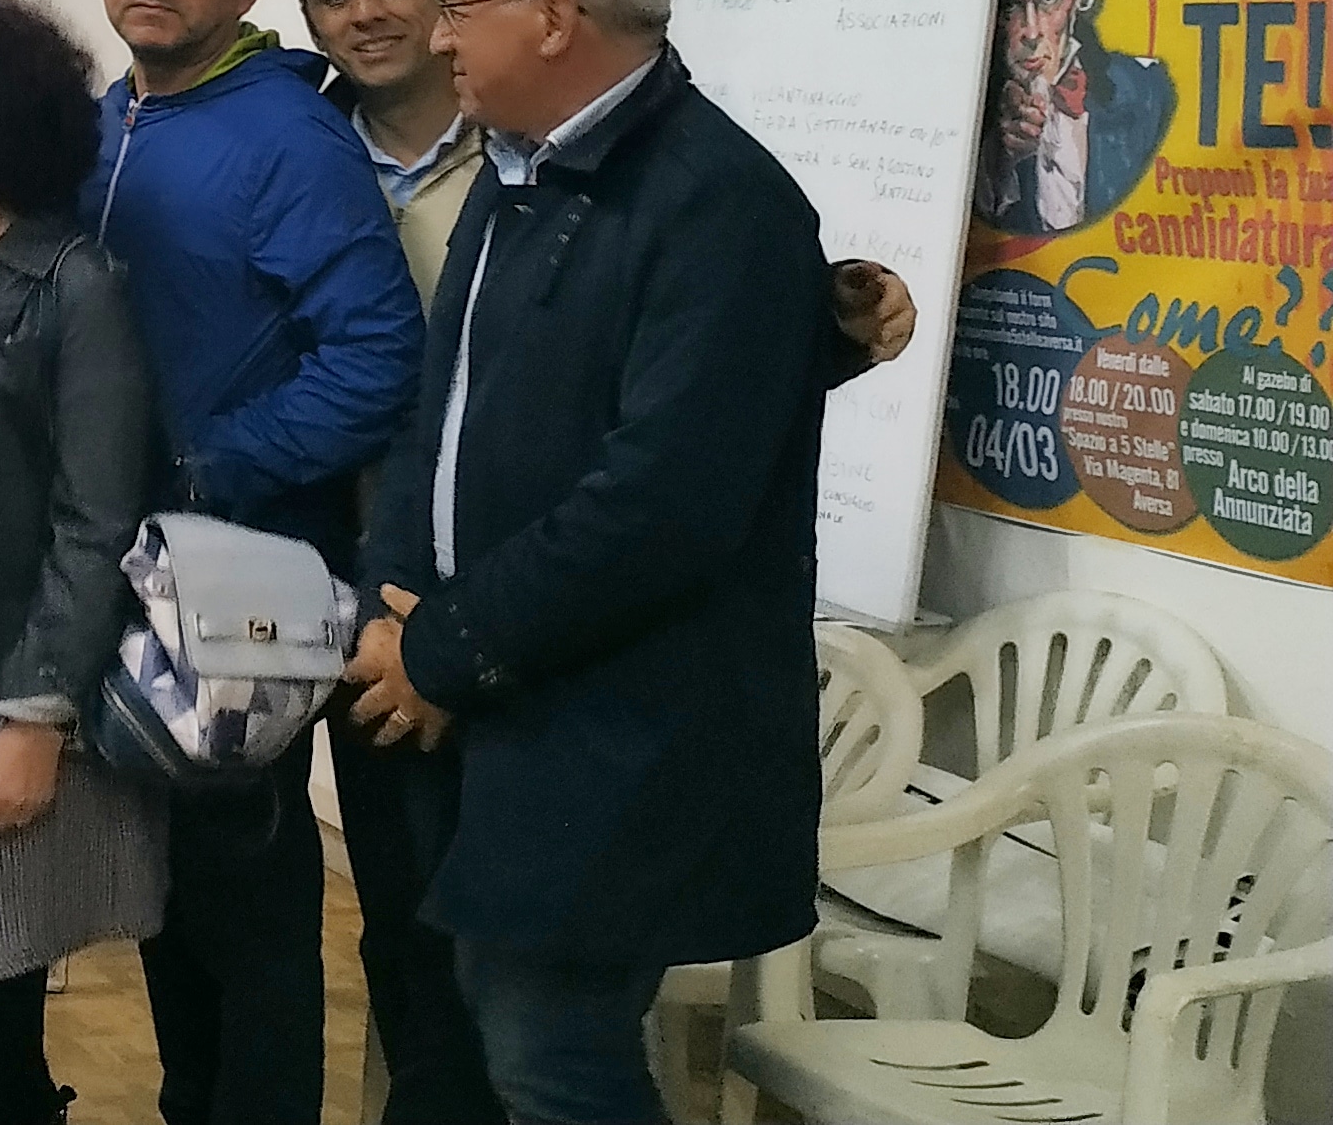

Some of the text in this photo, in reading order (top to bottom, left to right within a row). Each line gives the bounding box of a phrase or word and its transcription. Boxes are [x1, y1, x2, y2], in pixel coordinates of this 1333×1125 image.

[1182, 1, 1333, 150] TE!
[1262, 159, 1288, 199] la
[991, 361, 1062, 417] 18.00
[1068, 374, 1109, 407] 18.00
[1122, 383, 1176, 417] 20.00
[1242, 364, 1256, 386] Al
[1188, 388, 1236, 417] sabato
[1237, 393, 1276, 423] 17.00
[1288, 401, 1331, 431] 19.00
[965, 412, 1060, 483] 04/03
[1120, 434, 1132, 456] 5
[1179, 418, 1189, 437] e
[1190, 417, 1251, 447] domenica
[1251, 427, 1290, 454] 10.00
[1132, 488, 1174, 517] Aversa
[1227, 458, 1320, 505] Arco della
[1212, 486, 1313, 536] Annunziata
